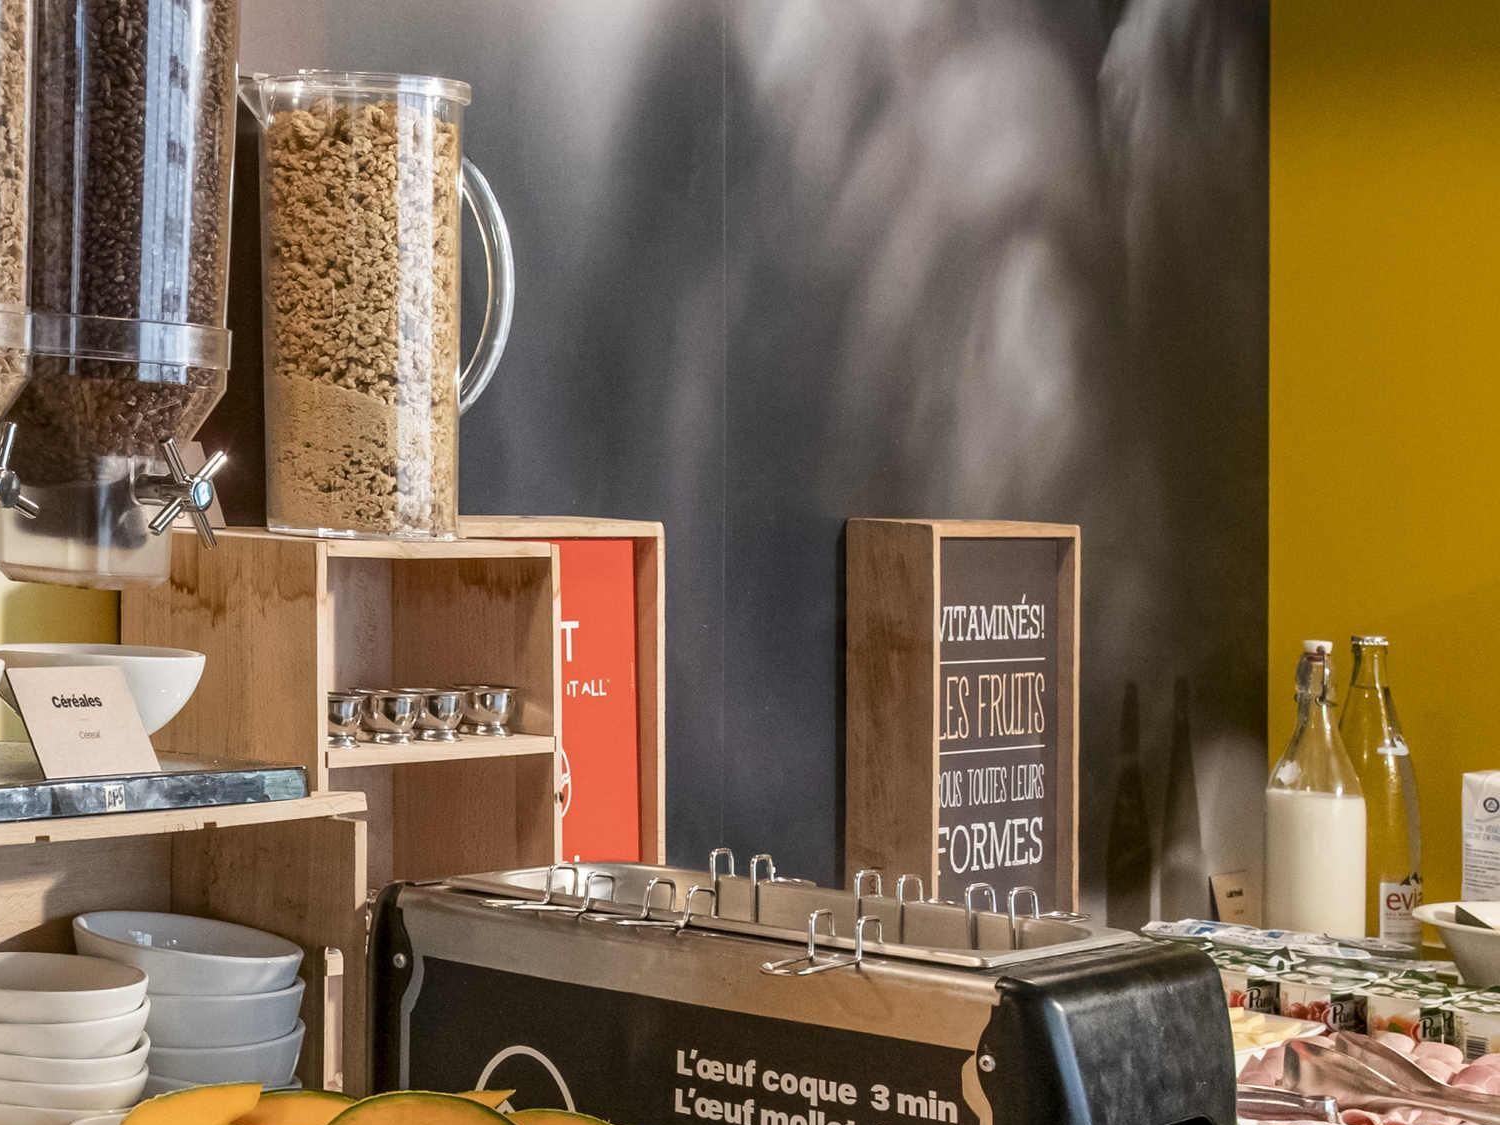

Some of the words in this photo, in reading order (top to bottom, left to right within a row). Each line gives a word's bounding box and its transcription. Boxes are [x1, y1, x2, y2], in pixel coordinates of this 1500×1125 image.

[51, 693, 103, 709] Céréales
[978, 671, 1045, 738] FRUITS
[938, 770, 963, 809] OUS
[967, 766, 1008, 807] TOUTES
[1010, 763, 1045, 801] LEURS
[762, 1070, 858, 1107] coque
[869, 1084, 891, 1112] 3
[896, 1090, 959, 1125] min
